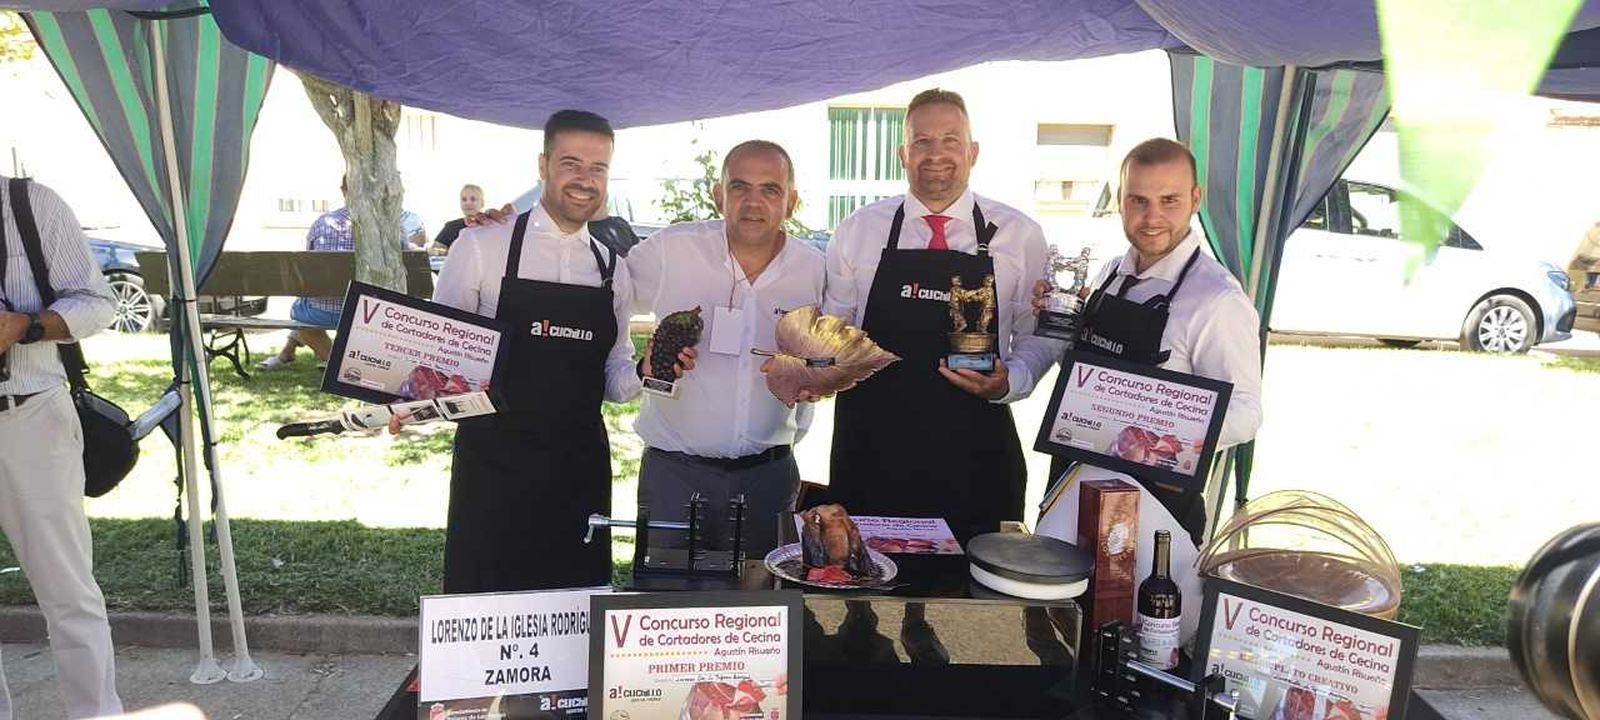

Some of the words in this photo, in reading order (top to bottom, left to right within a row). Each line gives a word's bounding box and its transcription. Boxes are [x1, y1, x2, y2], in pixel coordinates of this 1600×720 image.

[364, 300, 380, 324] V
[385, 306, 440, 331] Concurso
[443, 322, 495, 346] Regional
[381, 321, 394, 332] de
[395, 323, 446, 346] Cortadores
[448, 337, 460, 348] de
[461, 340, 492, 356] Cecina
[423, 352, 460, 368] PREMIO
[1077, 365, 1094, 388] V
[1097, 370, 1153, 393] Concurso
[1155, 382, 1213, 406] Regional
[1093, 383, 1106, 395] de
[1160, 397, 1174, 409] de
[1175, 401, 1208, 416] Cecina
[1136, 412, 1175, 429] PREMIO
[431, 617, 477, 644] LORENZO
[480, 616, 493, 641] DE
[496, 615, 509, 640] LA
[511, 613, 548, 638] IGLESIA
[551, 606, 590, 636] RODRÍGU
[610, 613, 632, 649] V
[639, 614, 710, 632] Concurso
[714, 611, 782, 632] Regional
[639, 634, 654, 647] de
[657, 632, 722, 647] Cortadores
[725, 631, 739, 644] de
[742, 630, 781, 644] Cecina
[1223, 597, 1243, 632] V
[1249, 607, 1317, 637] Concurso
[1322, 625, 1394, 658] Regional
[529, 642, 539, 658] 4
[714, 646, 747, 658] Agustín
[1246, 624, 1261, 638] de
[1329, 648, 1346, 661] de
[1348, 652, 1390, 674] Cecina
[485, 665, 551, 686] ZAMORA
[648, 662, 696, 675] PRIMER
[699, 660, 745, 673] PREMIO
